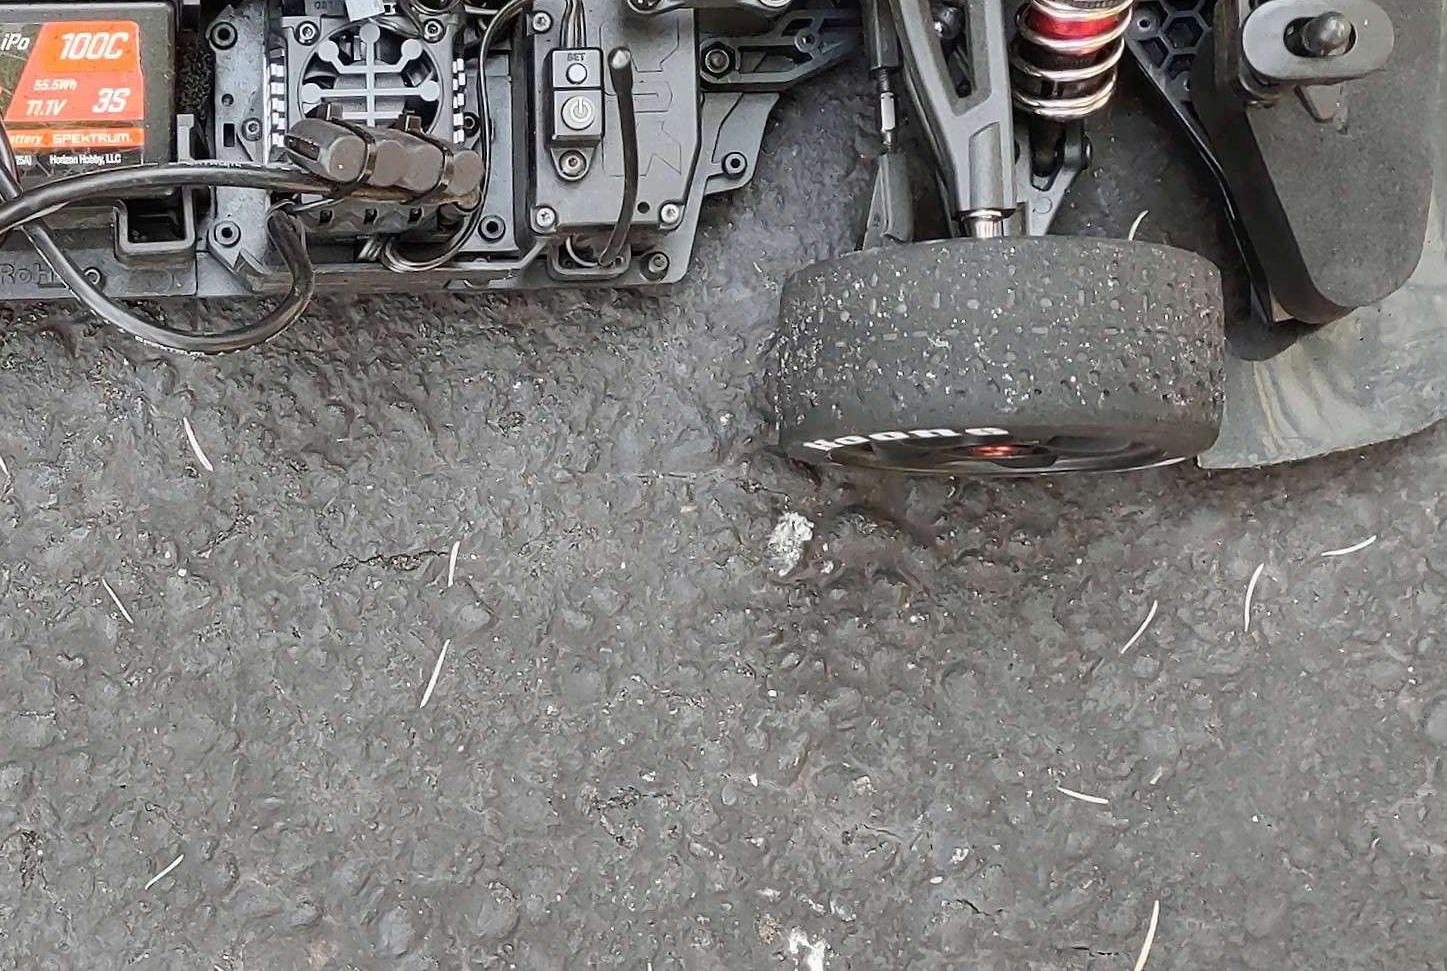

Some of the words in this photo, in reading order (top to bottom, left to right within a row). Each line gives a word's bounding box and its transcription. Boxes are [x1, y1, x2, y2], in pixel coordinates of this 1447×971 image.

[60, 32, 128, 60] 100C
[33, 79, 78, 91] 55.5Wh
[26, 99, 67, 116] 11.1V
[92, 88, 131, 113] 3S
[8, 134, 43, 146] attery
[52, 133, 132, 144] SPEKTRUM
[50, 155, 78, 165] Horizon
[79, 154, 105, 166] Hobby,
[106, 154, 122, 164] LLC
